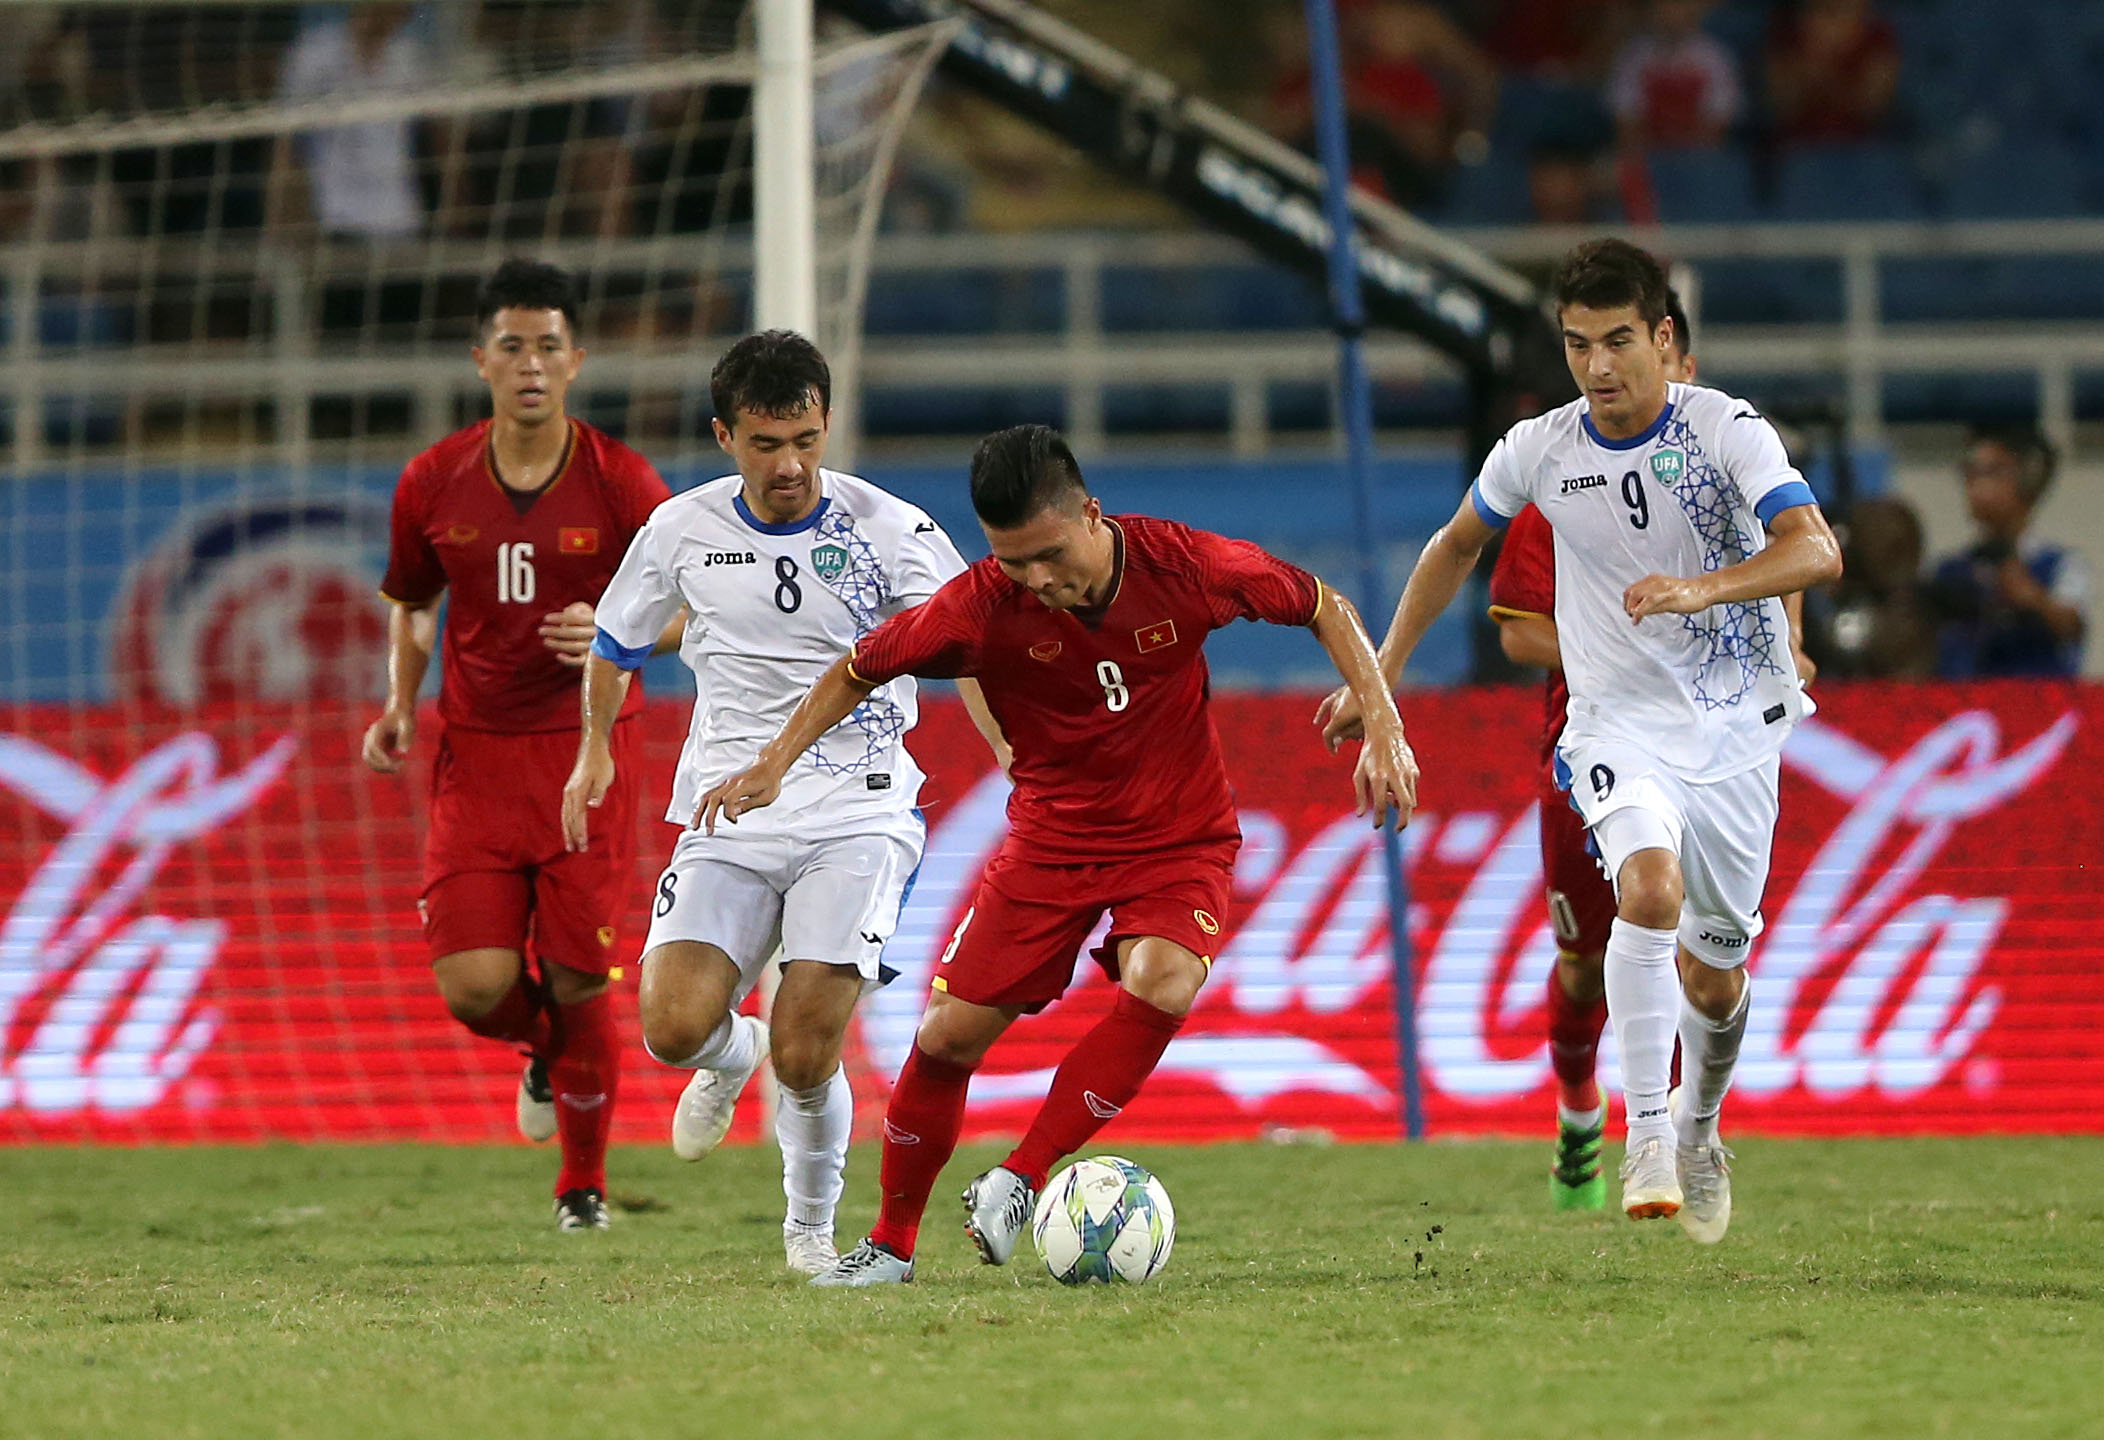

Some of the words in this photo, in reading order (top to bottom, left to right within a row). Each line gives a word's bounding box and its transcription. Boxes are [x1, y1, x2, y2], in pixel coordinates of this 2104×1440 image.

[1654, 456, 1680, 472] UFA
[1621, 470, 1649, 530] 9
[497, 541, 536, 604] 16
[815, 551, 842, 567] UFA
[774, 555, 802, 614] 8
[1096, 660, 1130, 712] 8
[1589, 763, 1616, 803] 9
[656, 871, 678, 918] 8
